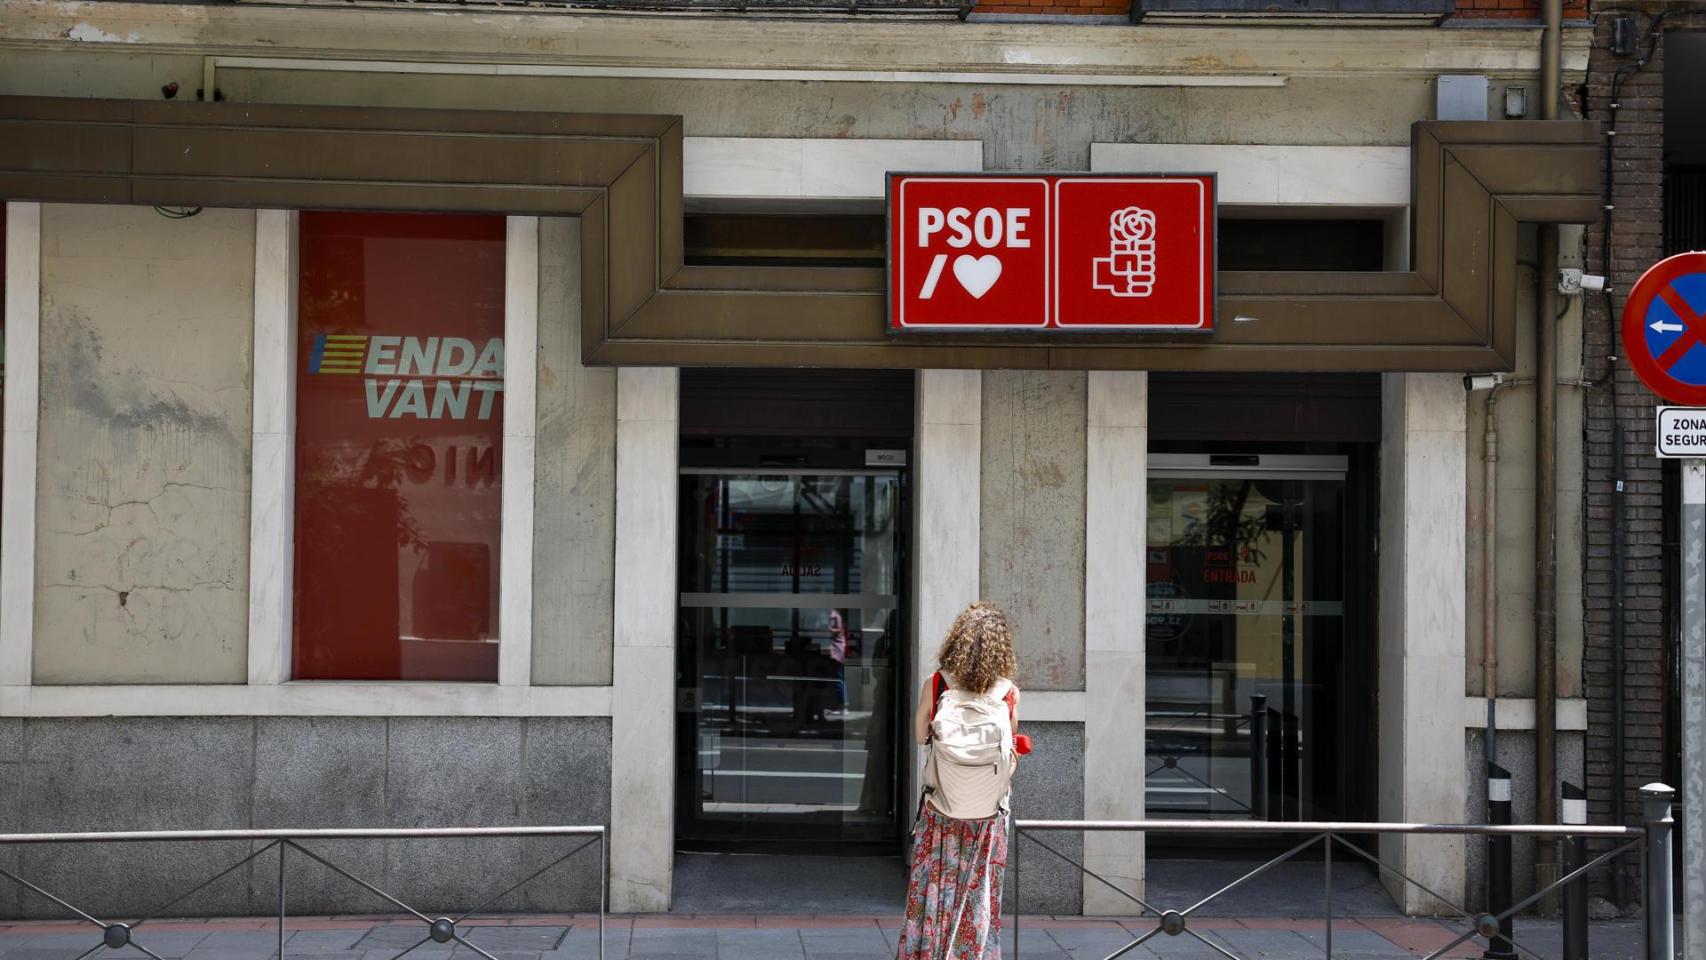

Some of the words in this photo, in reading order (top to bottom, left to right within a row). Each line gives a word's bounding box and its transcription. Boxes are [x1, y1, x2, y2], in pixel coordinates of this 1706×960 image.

[918, 207, 1031, 249] PSOE
[365, 336, 504, 376] ENDA
[365, 379, 504, 420] VANT
[1673, 419, 1706, 430] ZONA
[1666, 435, 1706, 446] SEGUR
[1204, 569, 1257, 584] ENTRADA
